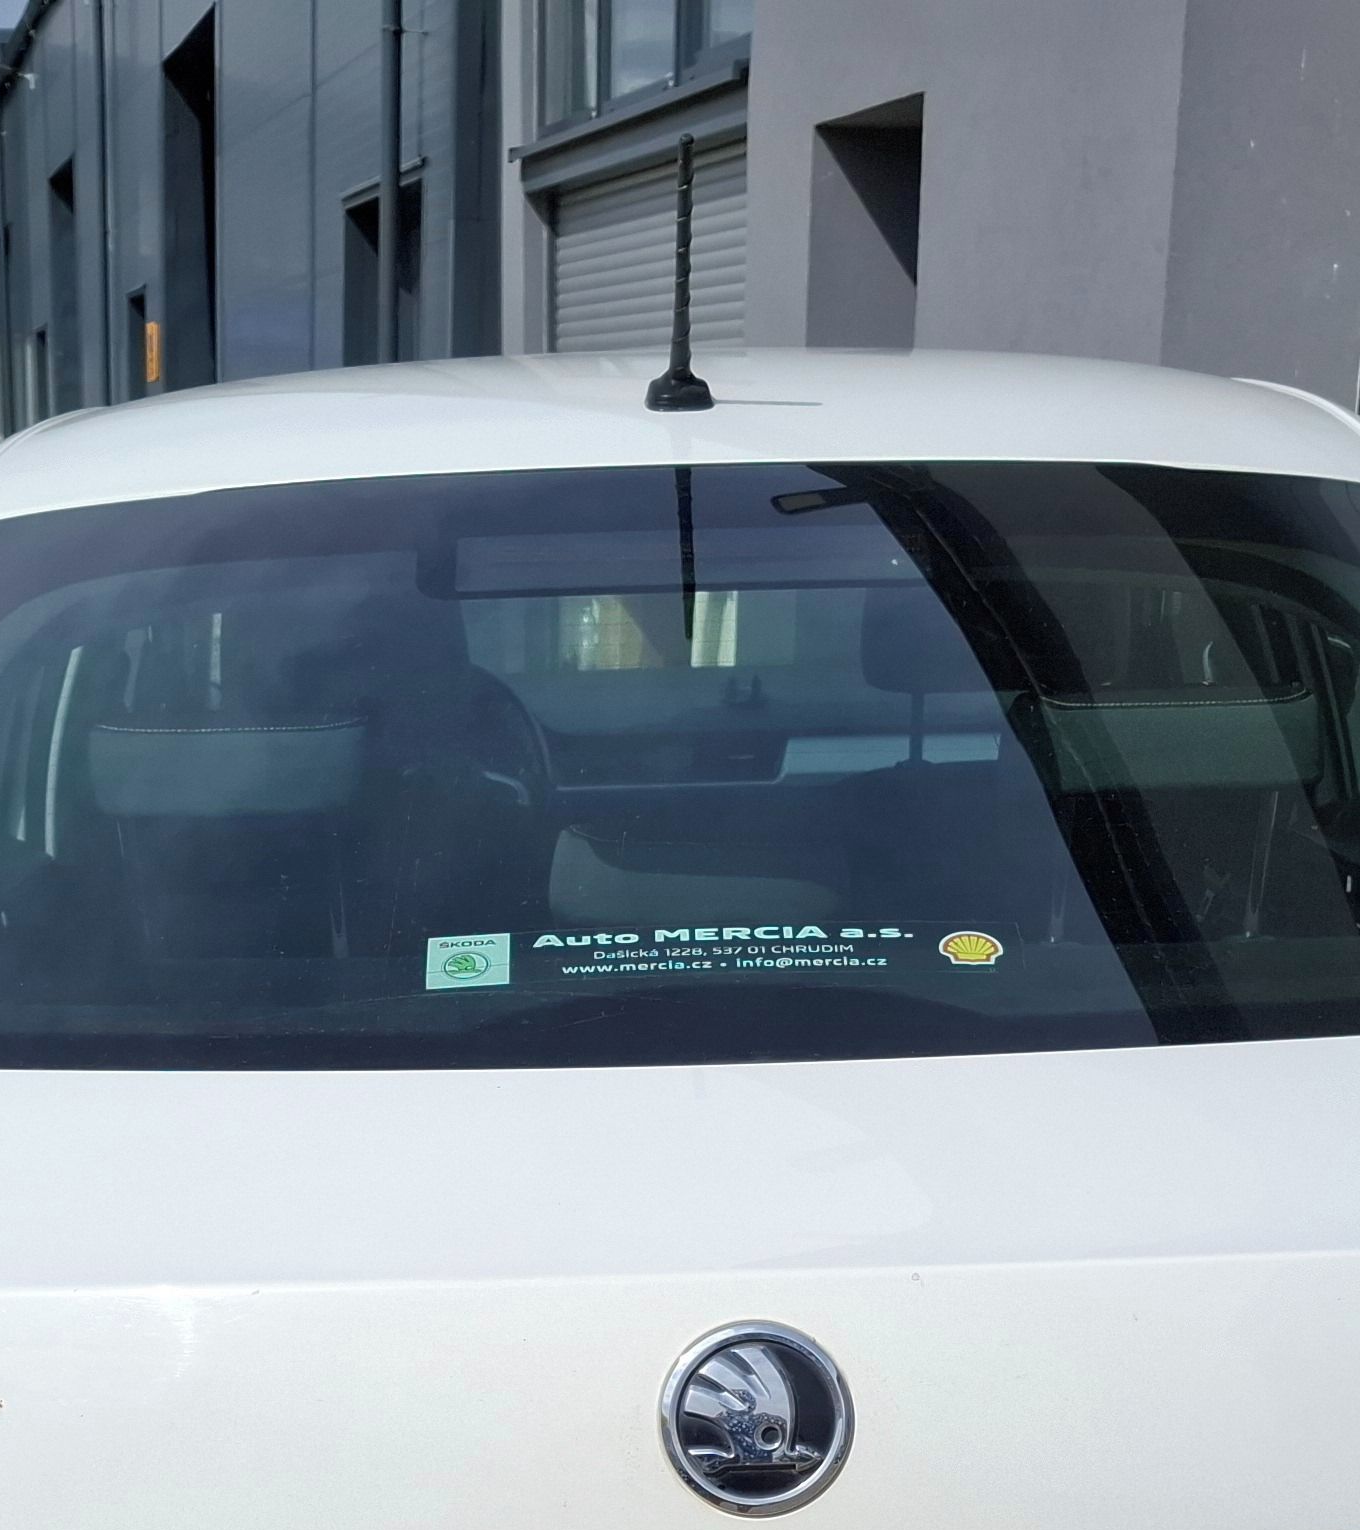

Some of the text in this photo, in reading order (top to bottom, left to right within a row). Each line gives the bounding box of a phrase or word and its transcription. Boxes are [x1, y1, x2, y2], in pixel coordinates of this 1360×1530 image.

[439, 939, 496, 949] ŠKODA
[533, 925, 914, 948] Auto MERCIA a.s.
[665, 947, 707, 957] 1228,
[712, 946, 741, 955] 537
[747, 946, 766, 955] 01
[771, 944, 854, 954] CHRUDIM
[562, 957, 888, 974] www.mercia.cz info@mercia.cz
